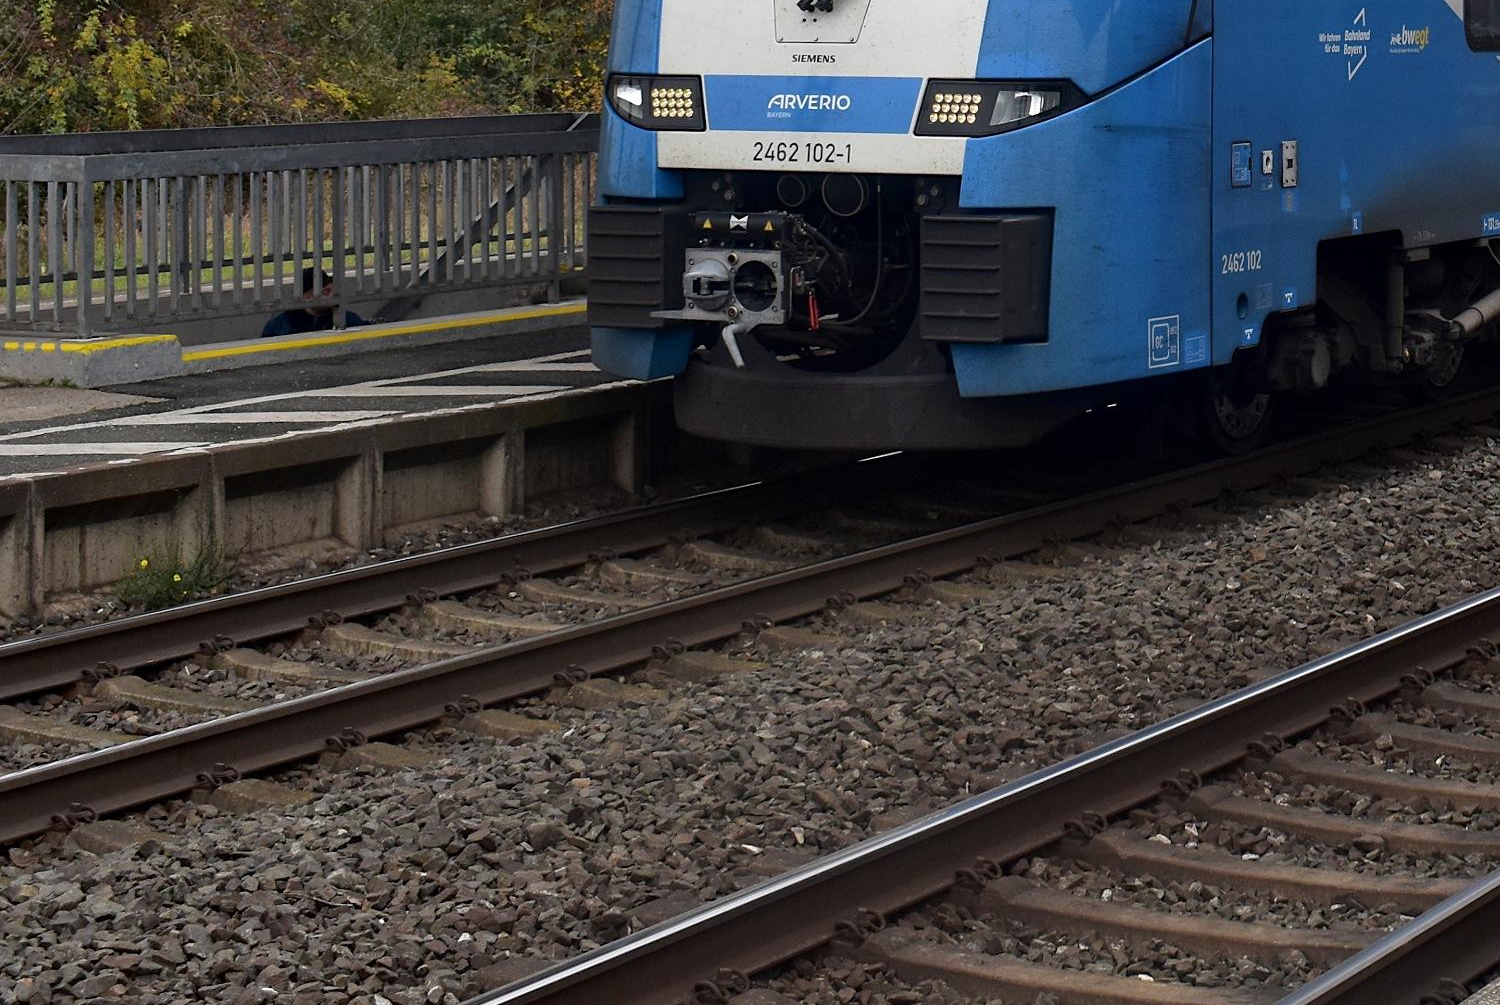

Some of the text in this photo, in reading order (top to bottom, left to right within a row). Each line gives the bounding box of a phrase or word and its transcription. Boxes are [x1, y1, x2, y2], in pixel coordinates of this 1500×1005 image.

[1344, 29, 1371, 41] Bahnland
[1402, 24, 1429, 50] bwegt
[1343, 43, 1362, 57] Bayern
[792, 54, 836, 64] SIEMENS
[767, 94, 851, 110] ARVERIO
[753, 142, 852, 164] 2462 102-1
[1221, 250, 1262, 275] 2462 102
